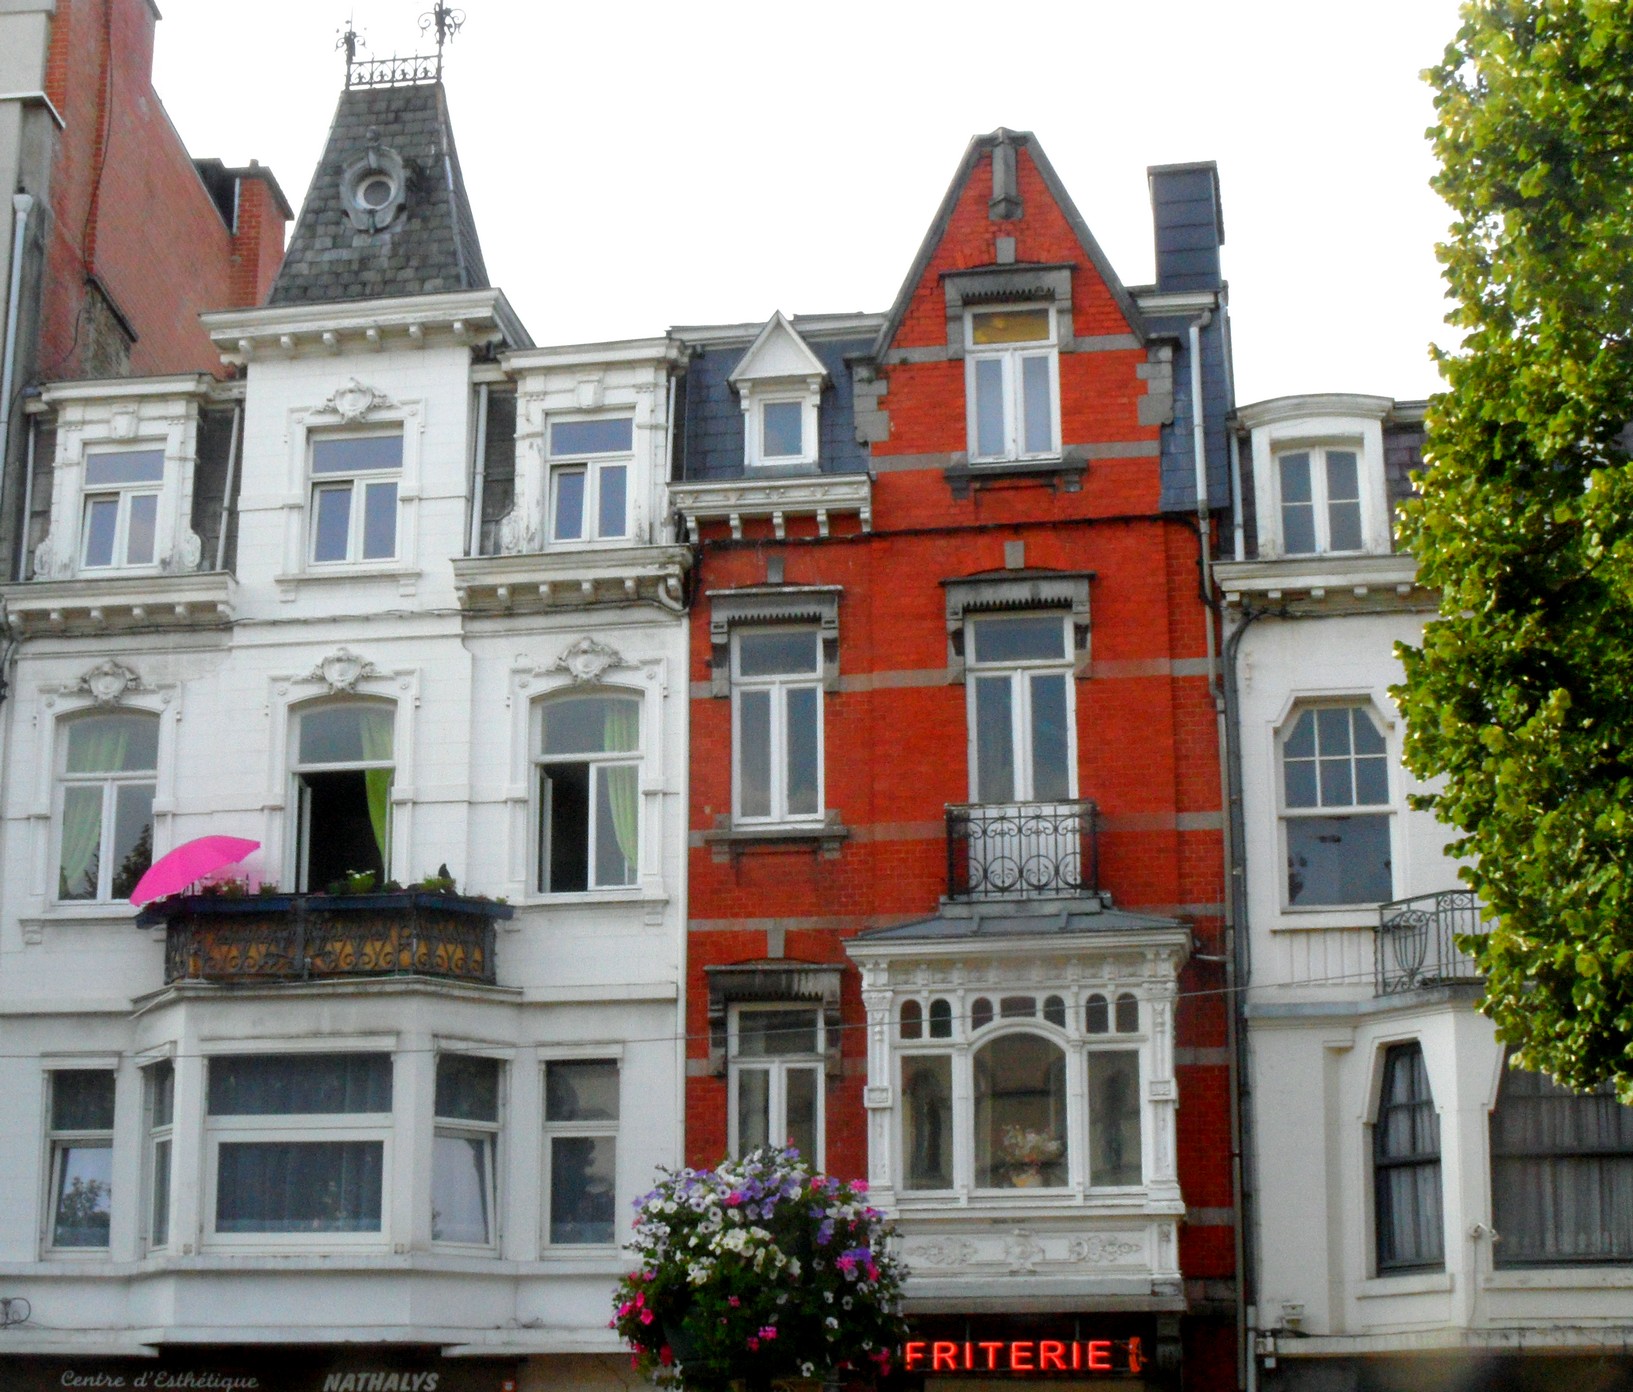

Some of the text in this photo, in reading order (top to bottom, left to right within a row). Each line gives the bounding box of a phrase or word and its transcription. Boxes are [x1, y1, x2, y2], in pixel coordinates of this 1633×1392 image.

[904, 1340, 1113, 1372] FRITERIE
[60, 1370, 260, 1392] Centre d'Esthétique
[322, 1371, 440, 1392] NATHALYS
